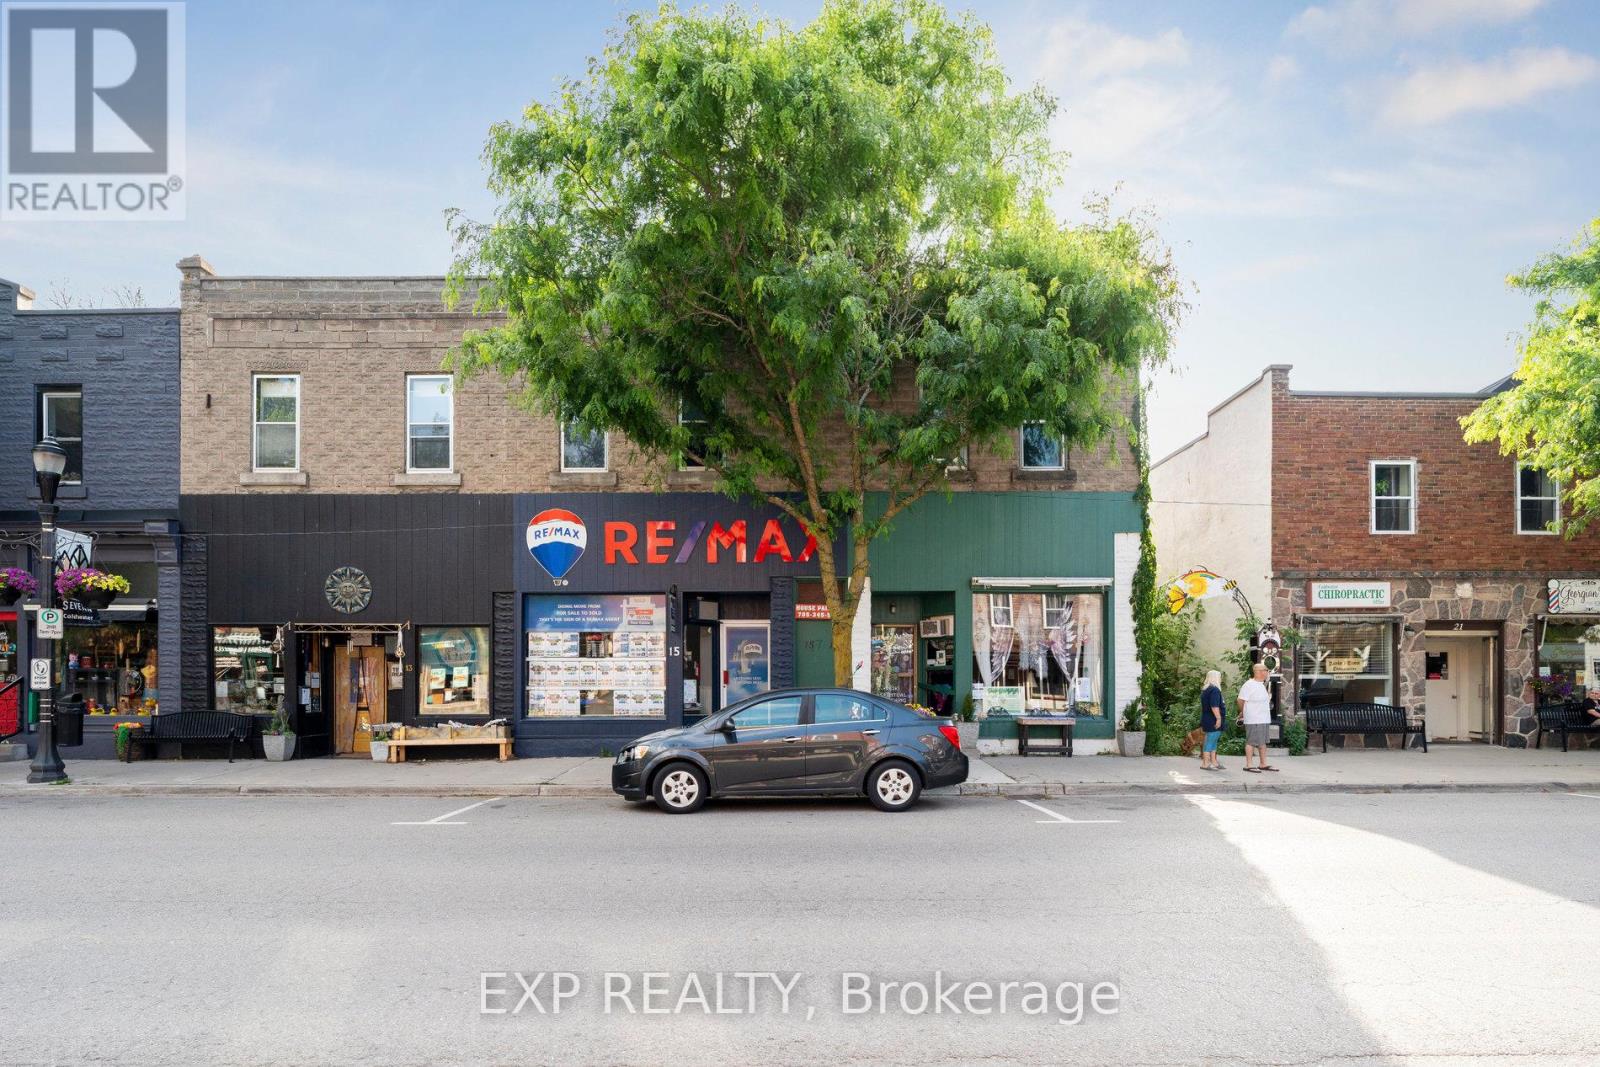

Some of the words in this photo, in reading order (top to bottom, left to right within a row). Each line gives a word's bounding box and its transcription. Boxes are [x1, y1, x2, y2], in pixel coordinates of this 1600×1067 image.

[534, 527, 579, 540] RE/MAX
[1318, 589, 1385, 599] CHIROPRACTIC
[1560, 584, 1599, 605] Georgian
[63, 613, 94, 621] Coldwater
[1453, 623, 1464, 631] 21
[669, 646, 680, 657] 15
[406, 664, 413, 672] 13
